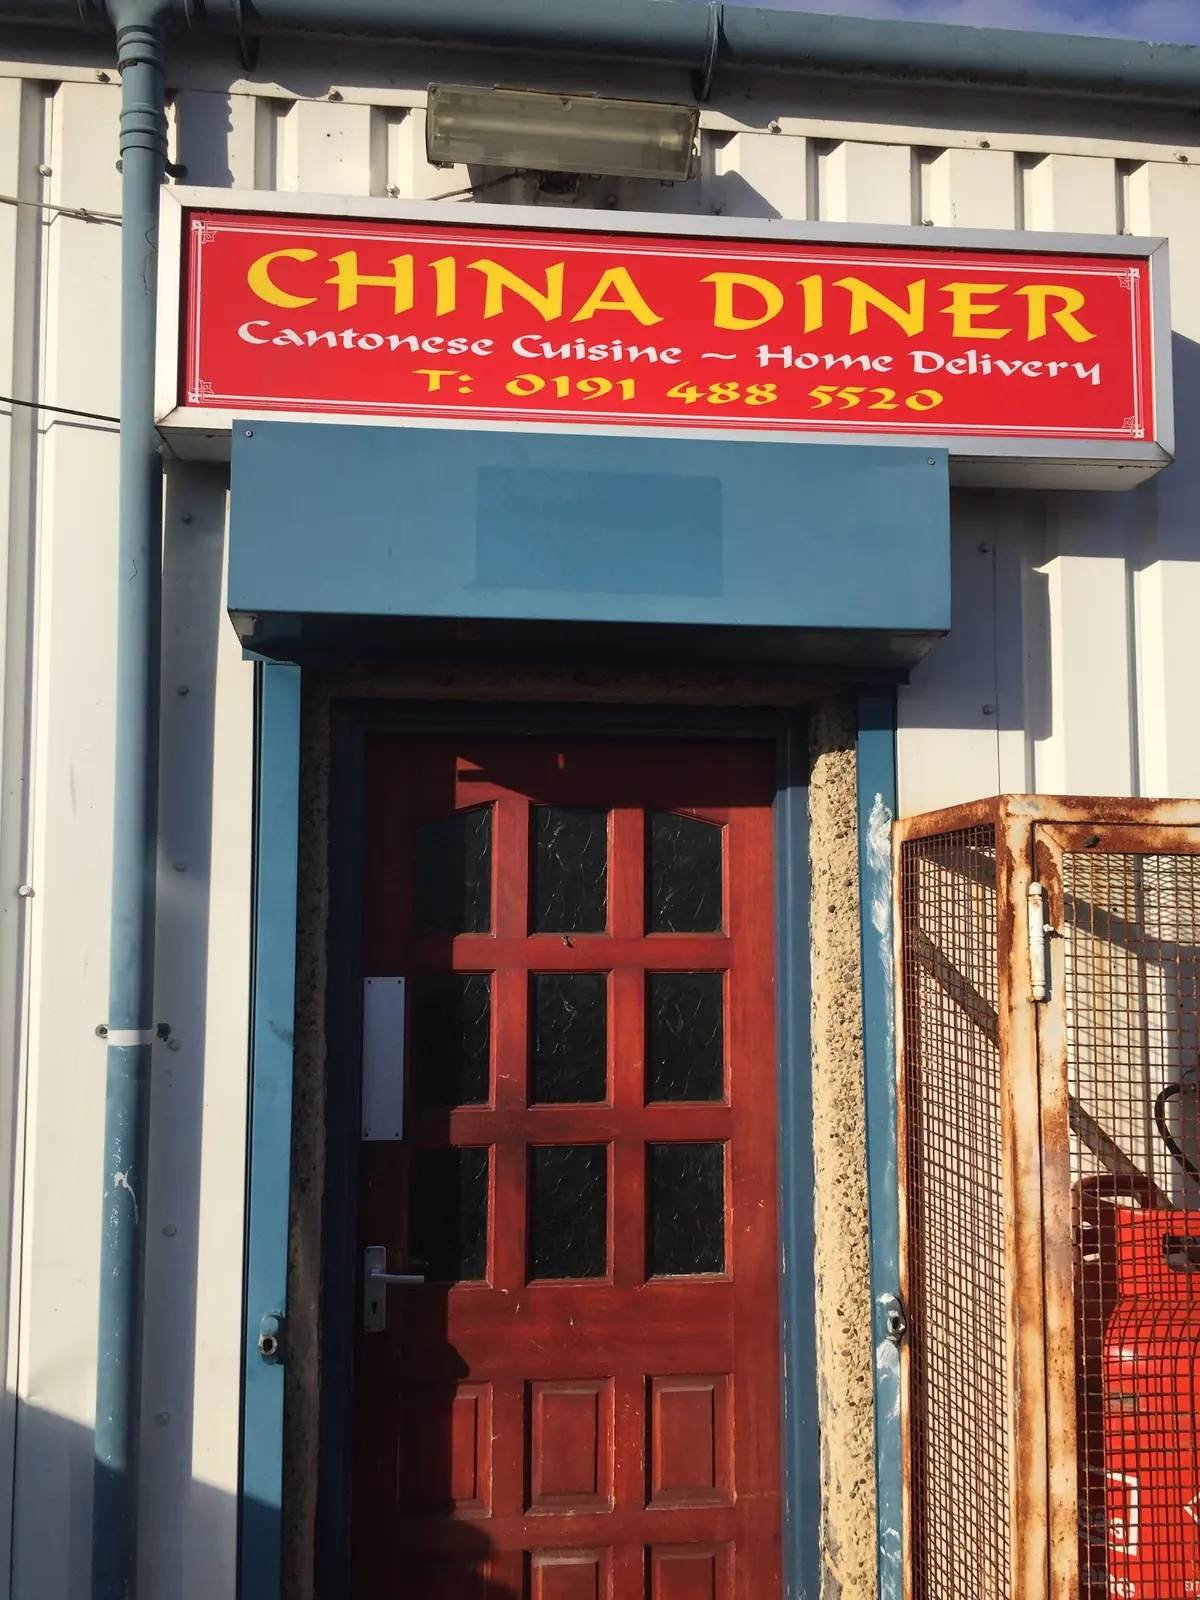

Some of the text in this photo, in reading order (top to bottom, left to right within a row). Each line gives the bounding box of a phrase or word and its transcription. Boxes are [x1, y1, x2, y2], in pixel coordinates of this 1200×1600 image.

[248, 248, 1097, 343] CHINA DINER
[237, 319, 494, 356] Cantonese
[511, 334, 682, 365] Cuisine
[755, 344, 894, 379] Home
[908, 349, 1101, 386] Delivery
[412, 368, 944, 412] T: 0191 488 5520
